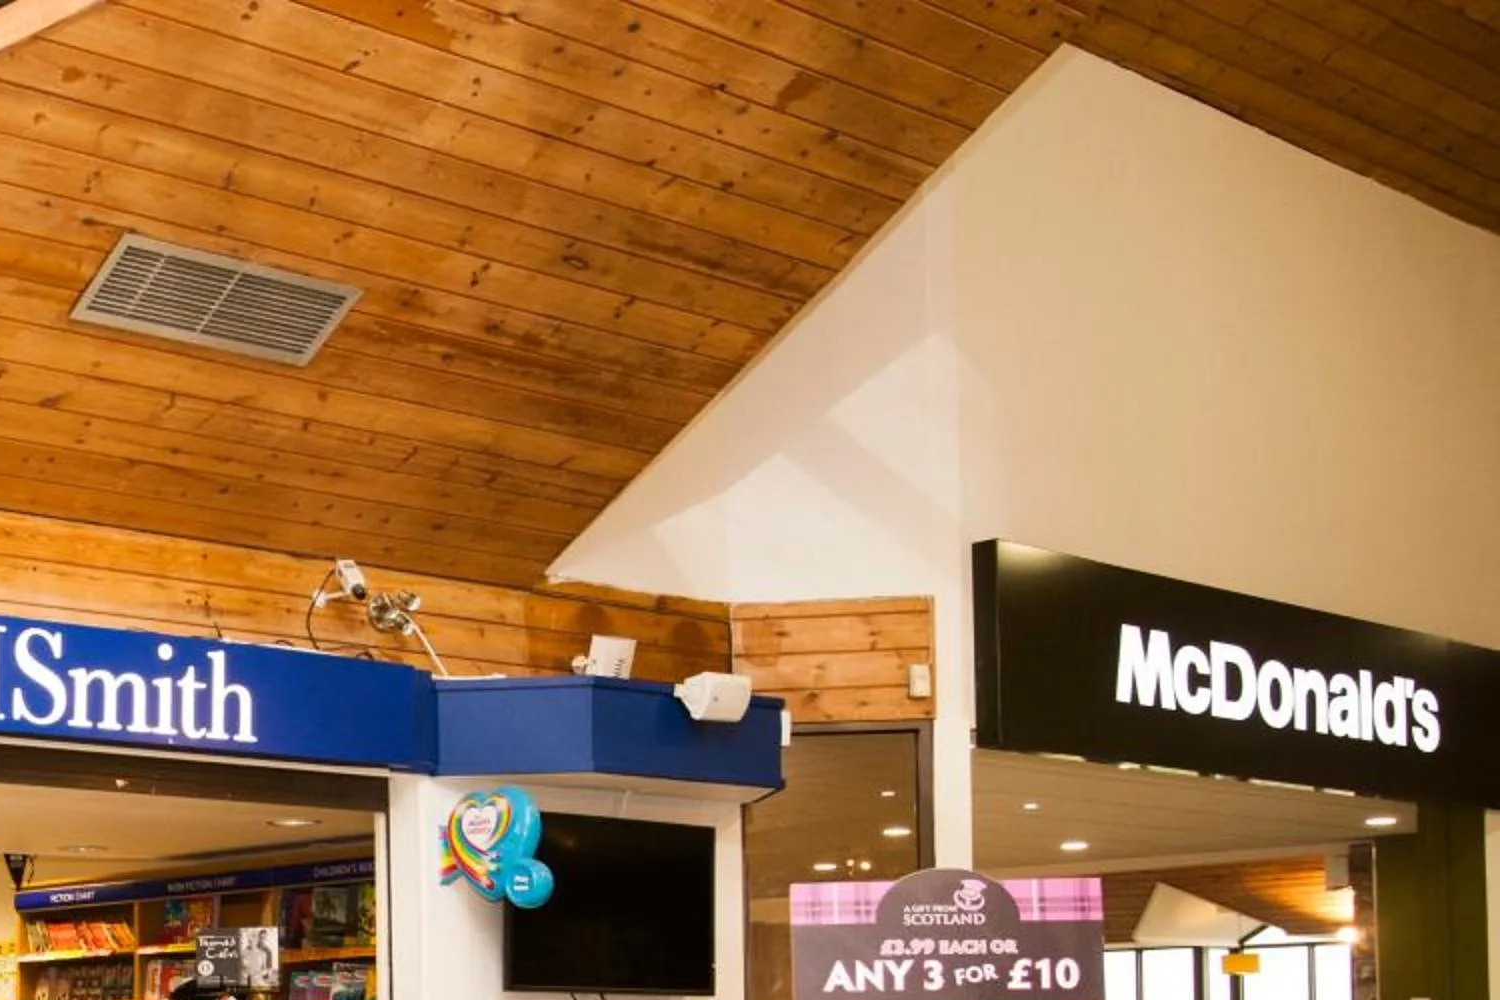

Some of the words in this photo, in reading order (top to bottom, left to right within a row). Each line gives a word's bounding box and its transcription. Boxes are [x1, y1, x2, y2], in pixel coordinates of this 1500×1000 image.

[1114, 622, 1441, 754] McDonald's
[903, 913, 986, 926] SCOTLAND
[939, 939, 987, 955] EACH
[989, 939, 1018, 955] OR
[823, 959, 914, 993] ANY
[923, 959, 945, 991] 3
[953, 963, 999, 986] FOR
[1007, 957, 1081, 990] £10
